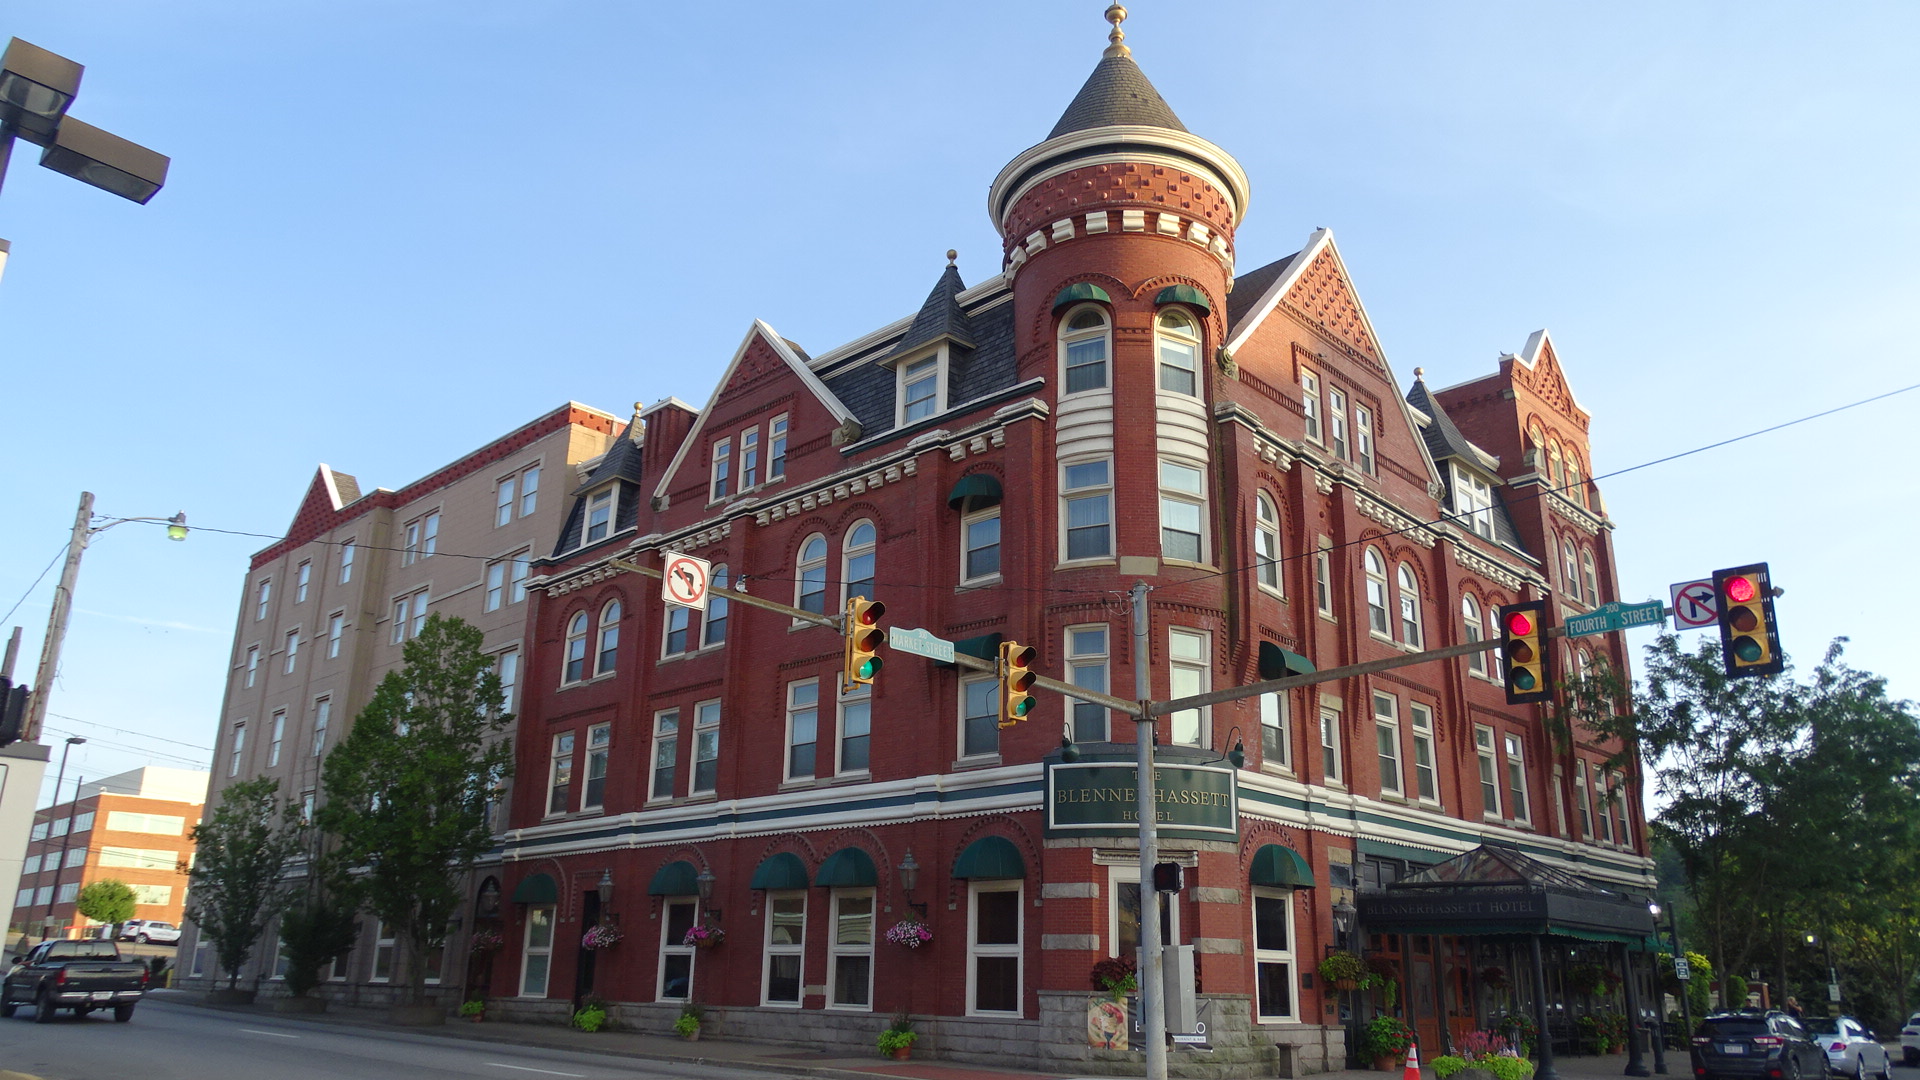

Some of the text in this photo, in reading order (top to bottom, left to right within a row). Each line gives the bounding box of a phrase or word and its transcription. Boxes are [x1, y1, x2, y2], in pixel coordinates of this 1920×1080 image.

[1606, 603, 1619, 614] 300
[1569, 606, 1658, 634] FOURTH STREET
[892, 632, 951, 658] MARKET STREET
[1132, 770, 1161, 780] TE
[1057, 788, 1229, 807] BLENNEHASSETT
[1123, 810, 1174, 821] HOEL
[1367, 901, 1536, 915] BLENNERHASSETT HOTEL
